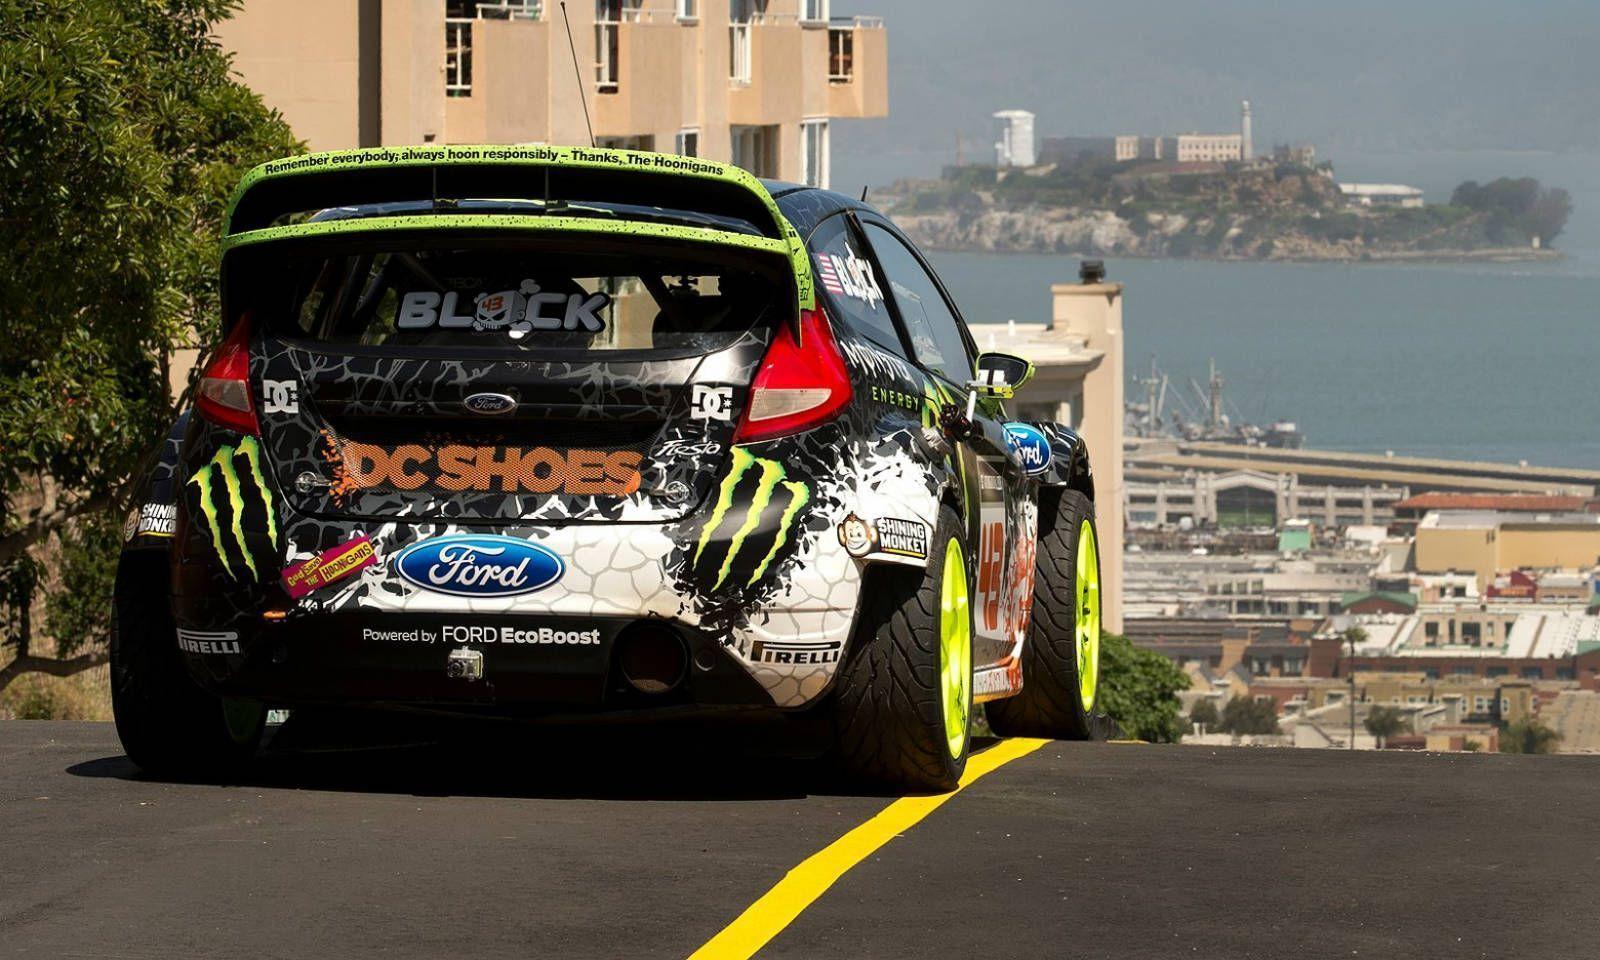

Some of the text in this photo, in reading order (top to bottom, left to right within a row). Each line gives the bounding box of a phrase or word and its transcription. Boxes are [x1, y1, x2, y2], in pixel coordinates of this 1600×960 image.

[265, 156, 329, 175] Remember
[402, 149, 445, 162] always
[447, 149, 480, 160] hoon
[482, 149, 559, 163] responsibly
[571, 150, 625, 166] Thanks,
[626, 153, 651, 166] The
[654, 156, 725, 177] Hoonigans
[474, 396, 505, 409] Ford
[871, 386, 919, 411] ENERGY
[654, 439, 721, 457] Fiesta
[342, 443, 643, 496] DC SHOES
[877, 518, 925, 540] SHINING
[880, 533, 926, 555] MONKEY
[428, 543, 532, 587] Ford
[176, 627, 240, 654] PIRELLI
[362, 626, 601, 645] Powered by FORD EcoBoost
[750, 640, 841, 664] PIRELLI
